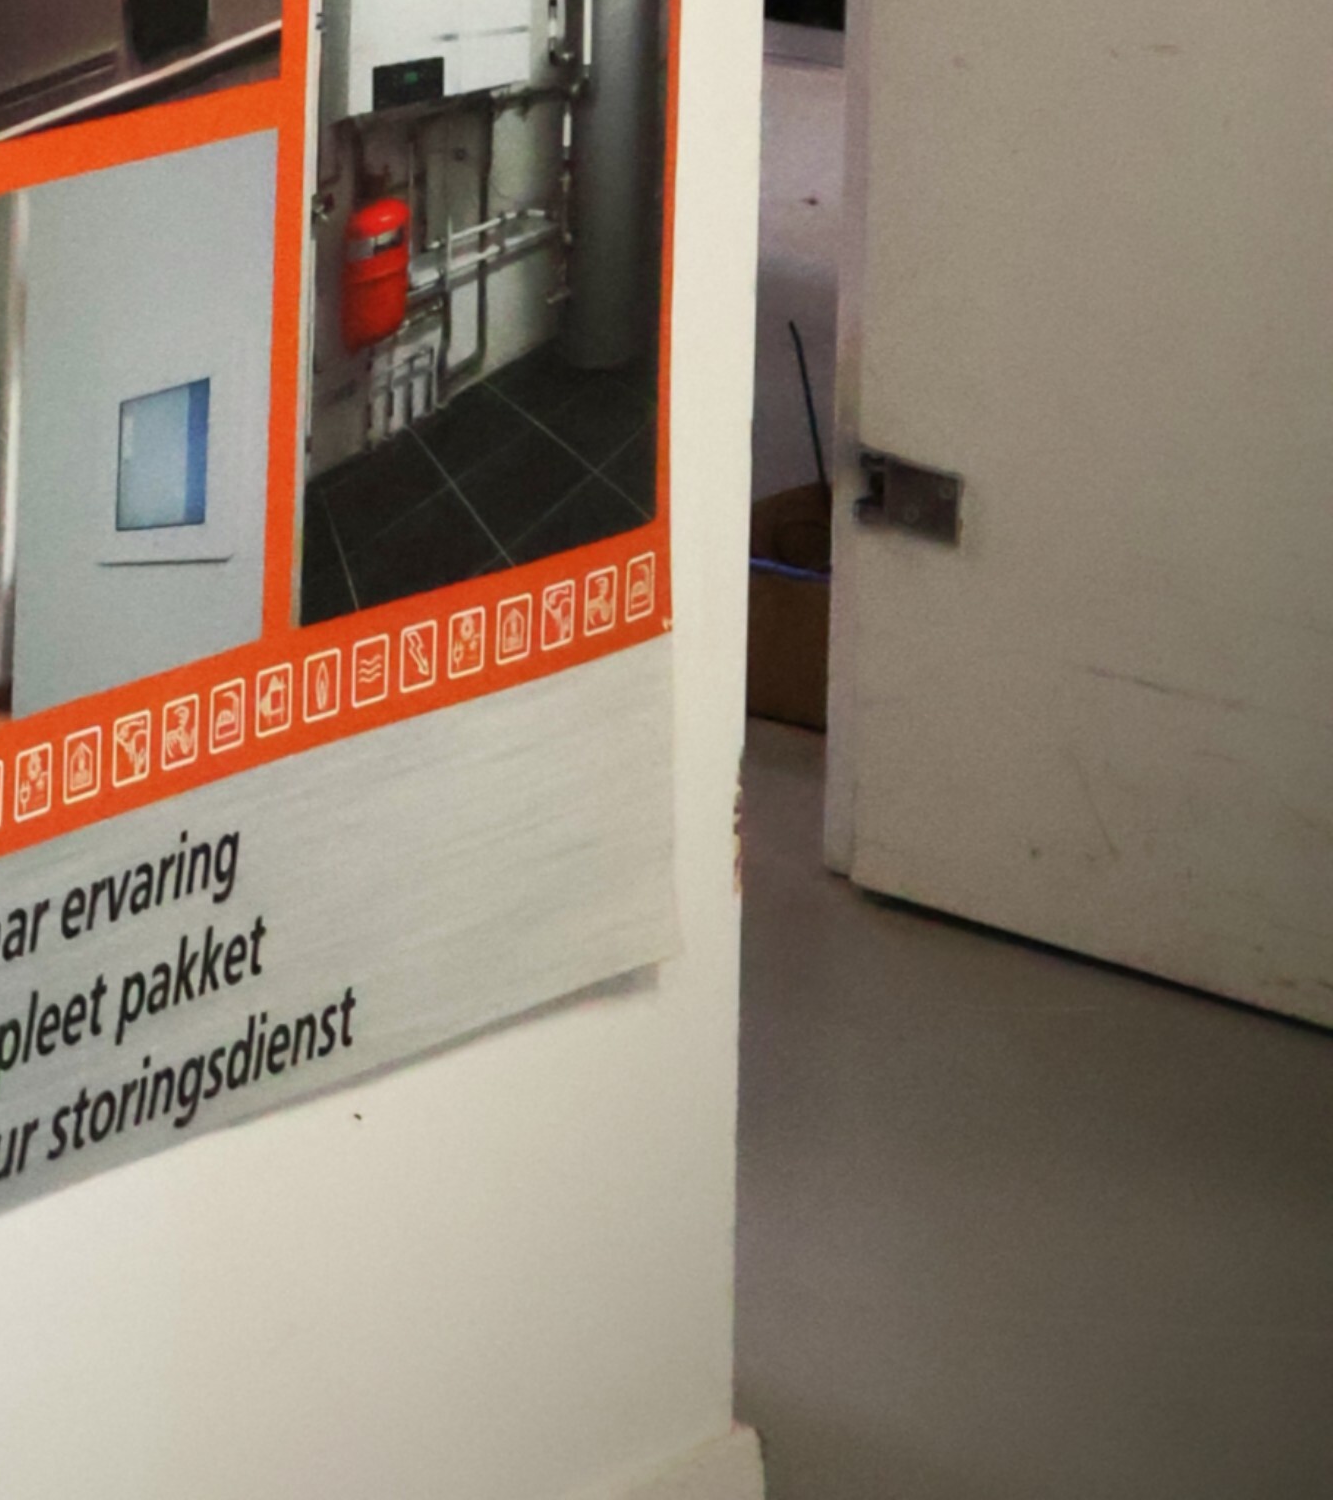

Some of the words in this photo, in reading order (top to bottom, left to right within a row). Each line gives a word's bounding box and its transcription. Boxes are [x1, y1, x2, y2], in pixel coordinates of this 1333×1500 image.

[60, 825, 241, 936] ervaring
[114, 915, 268, 1047] pakket
[48, 985, 357, 1160] storingsdienst
